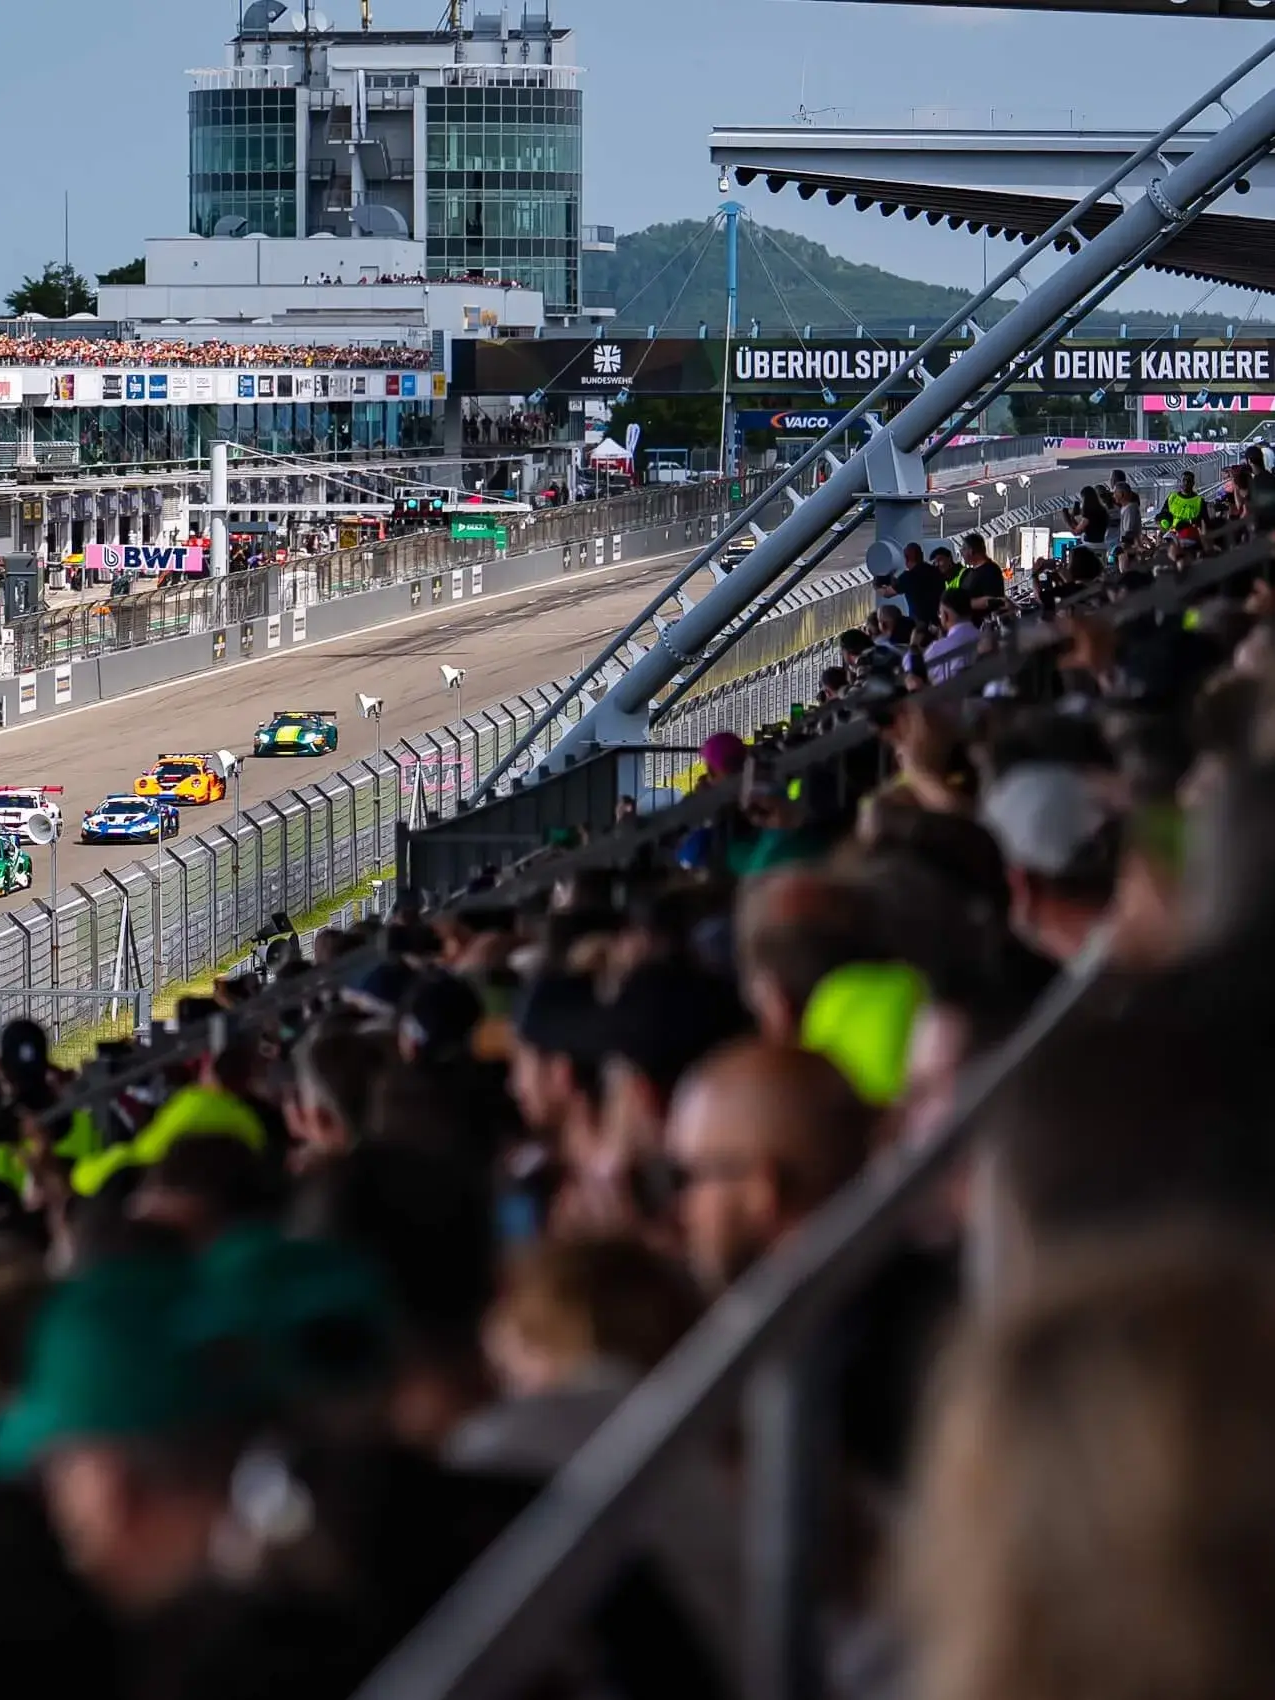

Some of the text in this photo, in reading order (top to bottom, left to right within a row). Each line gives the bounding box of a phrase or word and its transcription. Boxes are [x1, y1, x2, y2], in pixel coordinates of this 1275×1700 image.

[1054, 350, 1131, 379] DEINE
[1141, 350, 1270, 379] KARRIERE
[581, 376, 633, 385] BUNDESWEHR
[785, 416, 829, 428] VAICO
[124, 546, 187, 569] BWT
